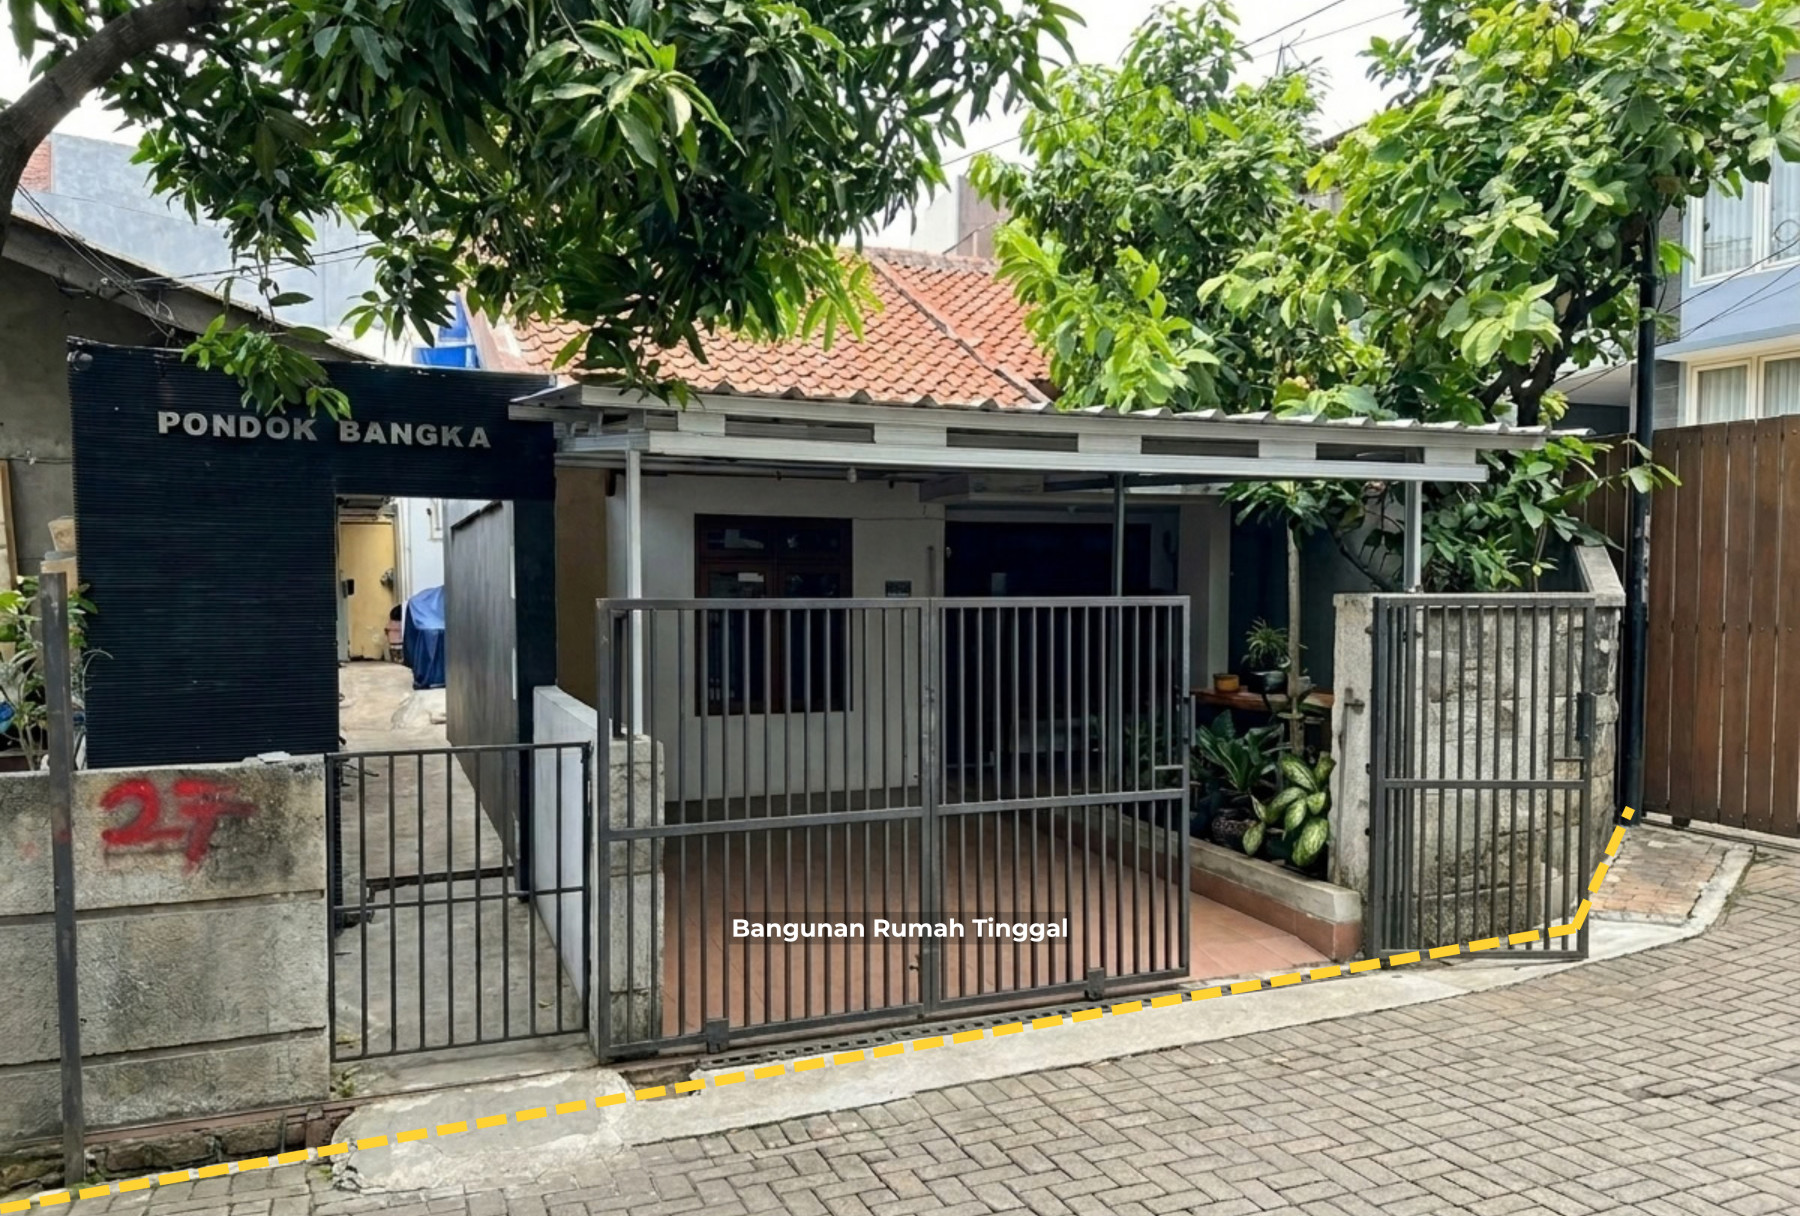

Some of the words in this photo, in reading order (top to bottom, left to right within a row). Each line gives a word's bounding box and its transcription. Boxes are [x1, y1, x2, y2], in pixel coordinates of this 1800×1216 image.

[157, 411, 318, 441] PONDOK
[340, 420, 492, 448] BANGKA
[101, 777, 258, 870] 27
